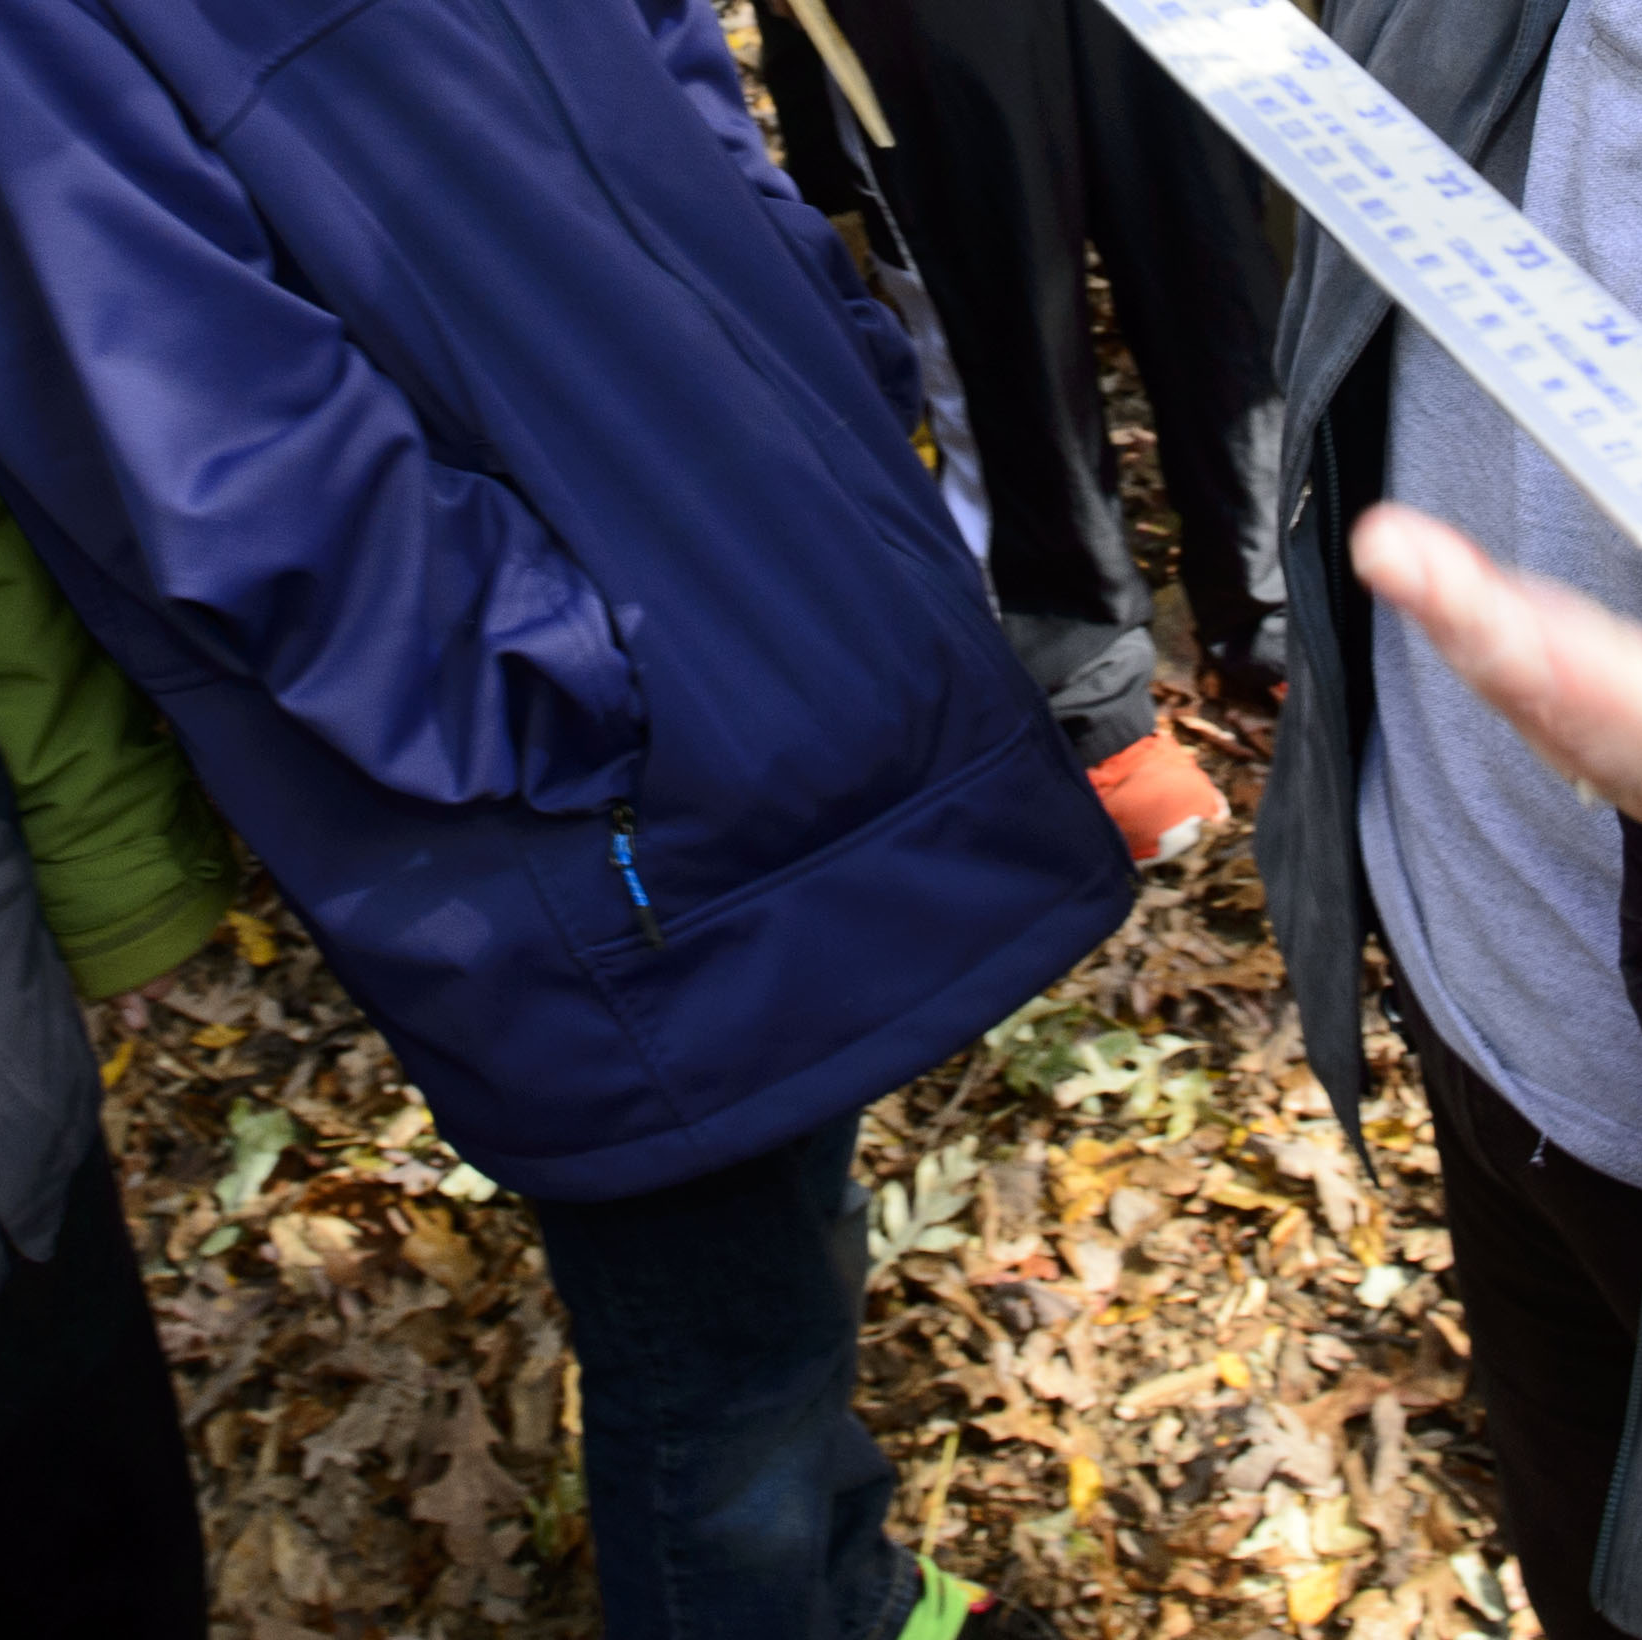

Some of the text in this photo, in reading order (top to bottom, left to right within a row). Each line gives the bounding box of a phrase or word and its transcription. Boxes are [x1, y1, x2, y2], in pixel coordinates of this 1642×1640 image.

[1424, 169, 1474, 200] 32
[1502, 238, 1552, 271] 33
[1581, 313, 1634, 348] 34
